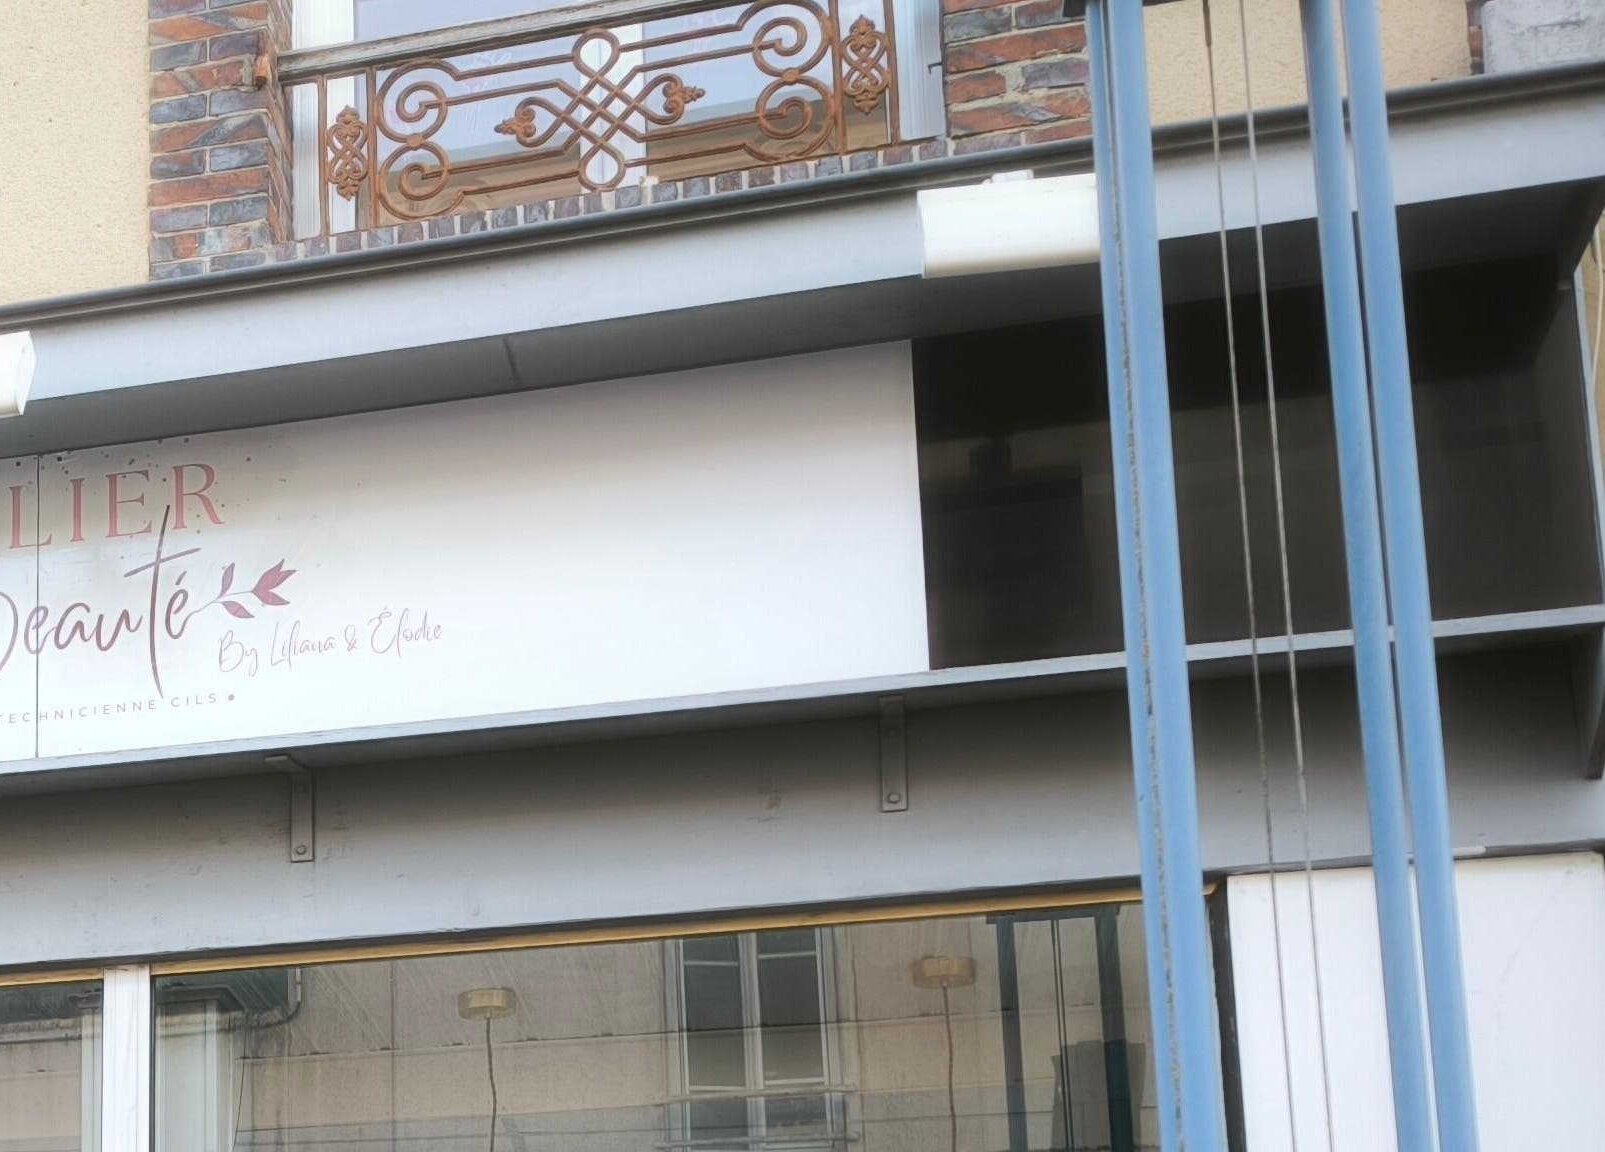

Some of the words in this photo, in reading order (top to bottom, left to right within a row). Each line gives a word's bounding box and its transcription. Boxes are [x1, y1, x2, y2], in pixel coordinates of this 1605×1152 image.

[218, 629, 259, 678] By
[344, 624, 359, 652] &
[170, 693, 218, 709] CILS
